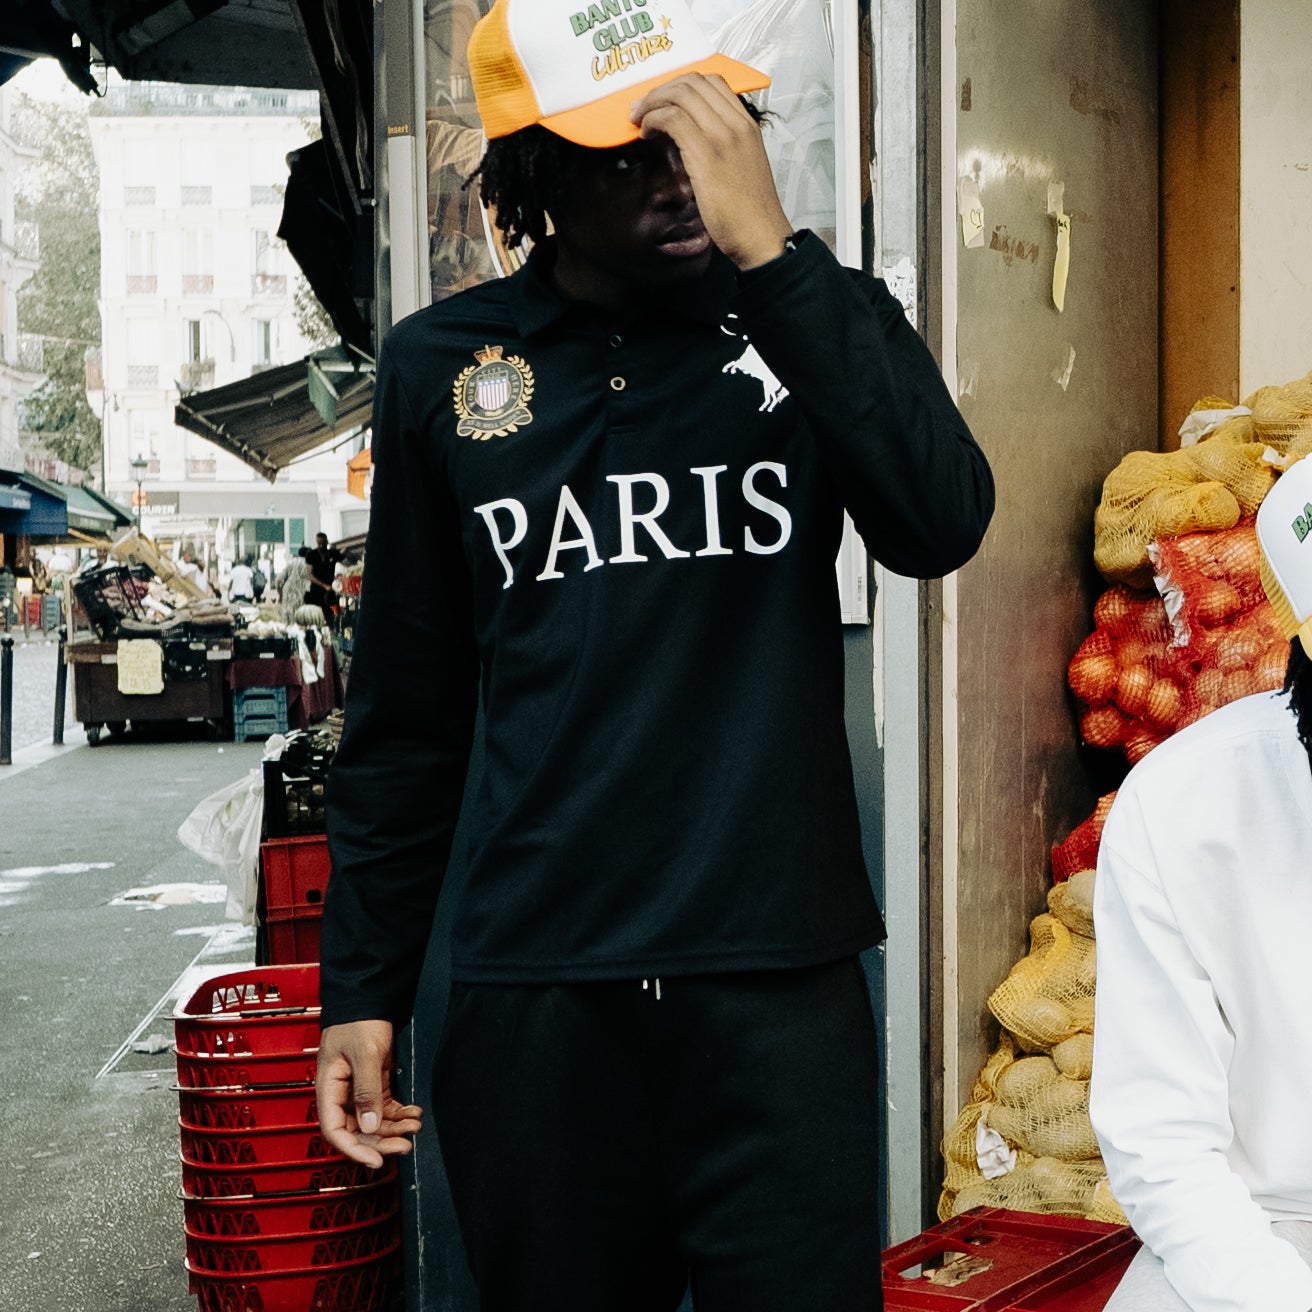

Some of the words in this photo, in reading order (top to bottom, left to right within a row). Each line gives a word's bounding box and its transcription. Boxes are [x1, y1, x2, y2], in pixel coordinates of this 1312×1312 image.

[592, 11, 655, 52] CLUB
[591, 32, 673, 81] CULTURE
[473, 461, 792, 589] PARIS
